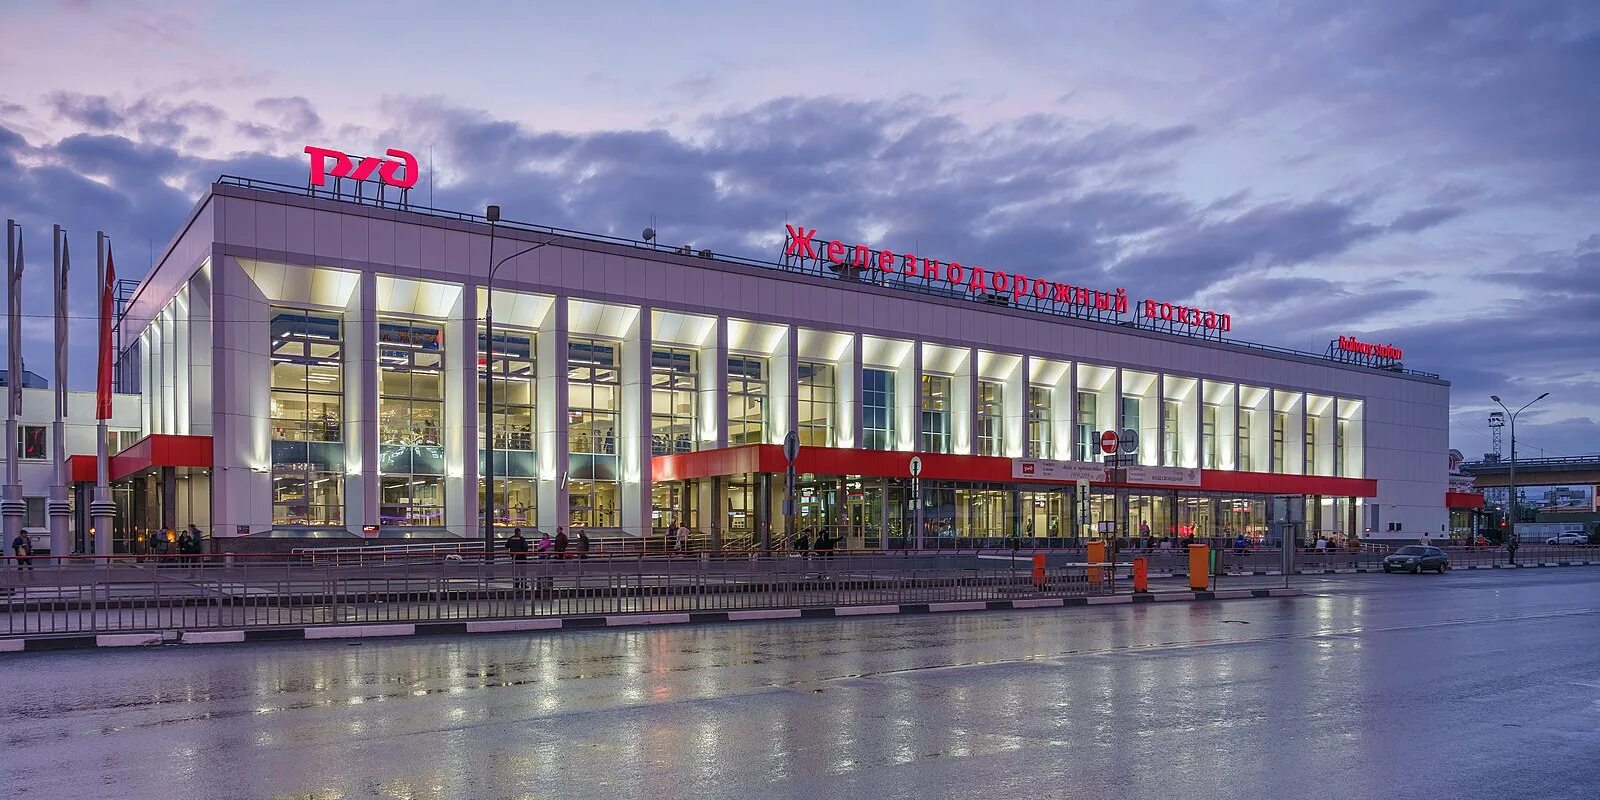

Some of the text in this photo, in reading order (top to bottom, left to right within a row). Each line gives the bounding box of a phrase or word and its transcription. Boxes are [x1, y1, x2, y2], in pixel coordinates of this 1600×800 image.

[786, 223, 1231, 332] Железнодорожный вокзал
[1339, 335, 1404, 360] Railway station
